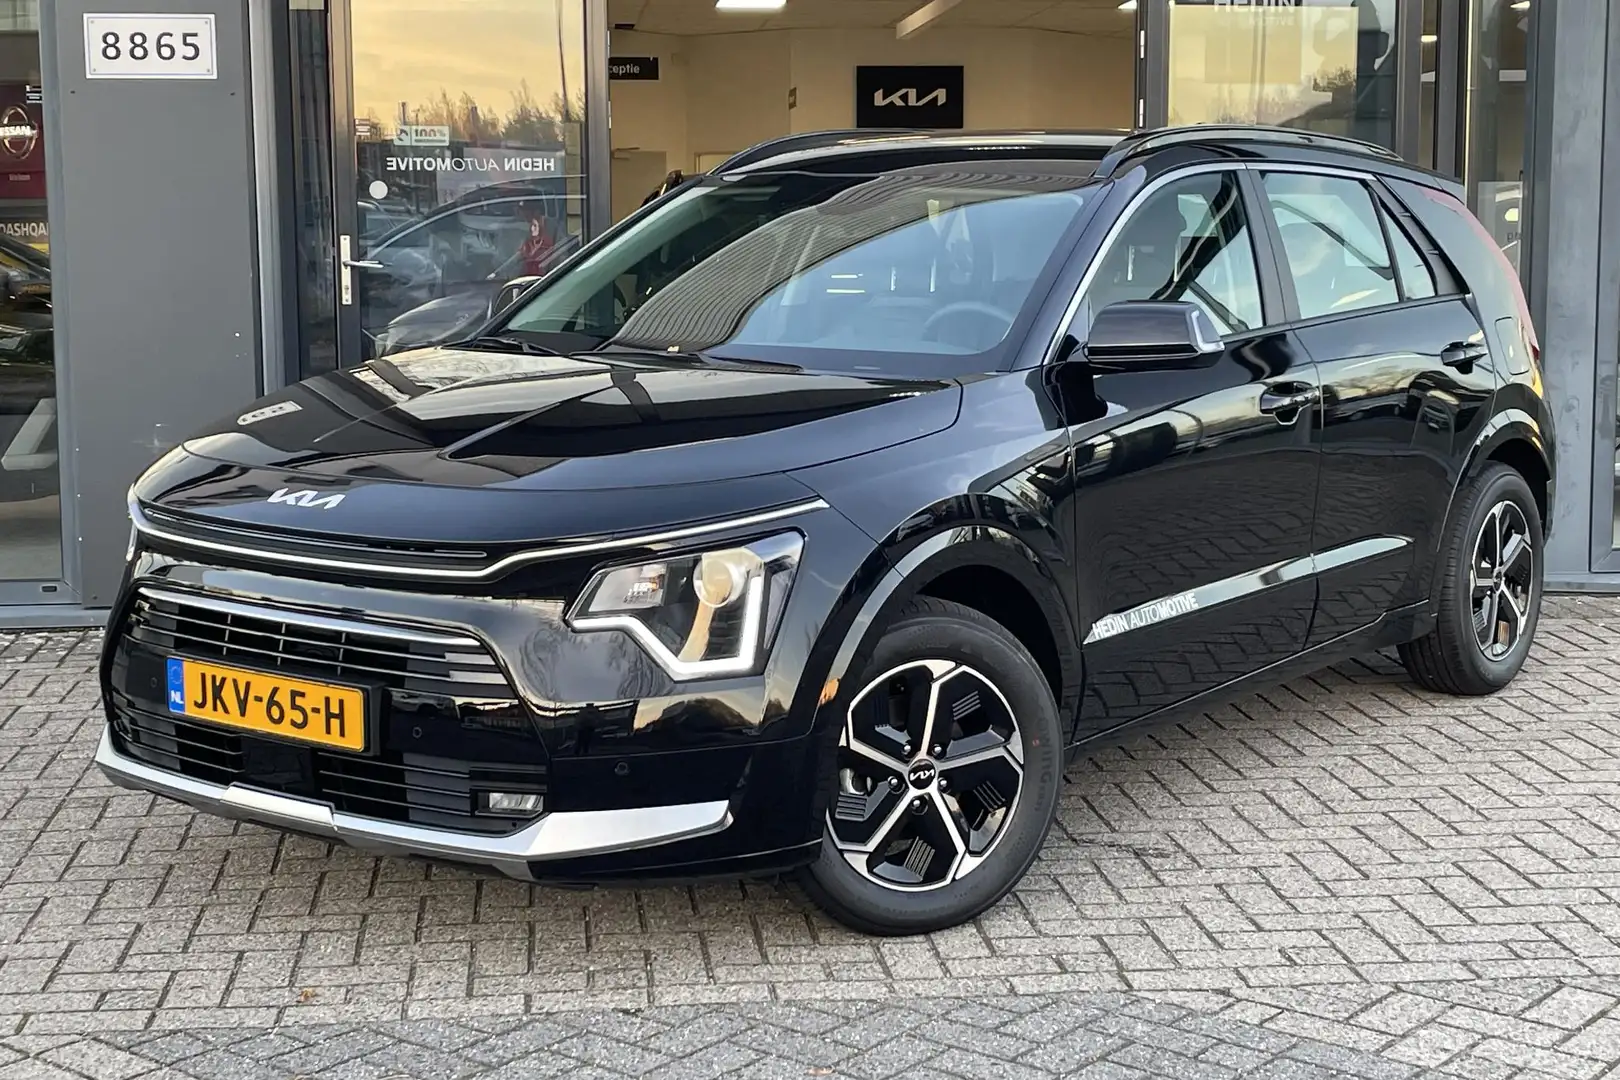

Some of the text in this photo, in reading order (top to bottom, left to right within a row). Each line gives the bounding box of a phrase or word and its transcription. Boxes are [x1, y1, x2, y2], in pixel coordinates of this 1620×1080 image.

[101, 31, 201, 61] 8865
[608, 63, 640, 76] ceptie
[874, 88, 946, 106] KIA
[267, 487, 346, 509] KIA
[1091, 592, 1199, 640] HEDIN AUTOMOTIVE
[171, 690, 184, 704] NL
[193, 672, 346, 738] JKV-65-H
[910, 768, 935, 781] KIA
